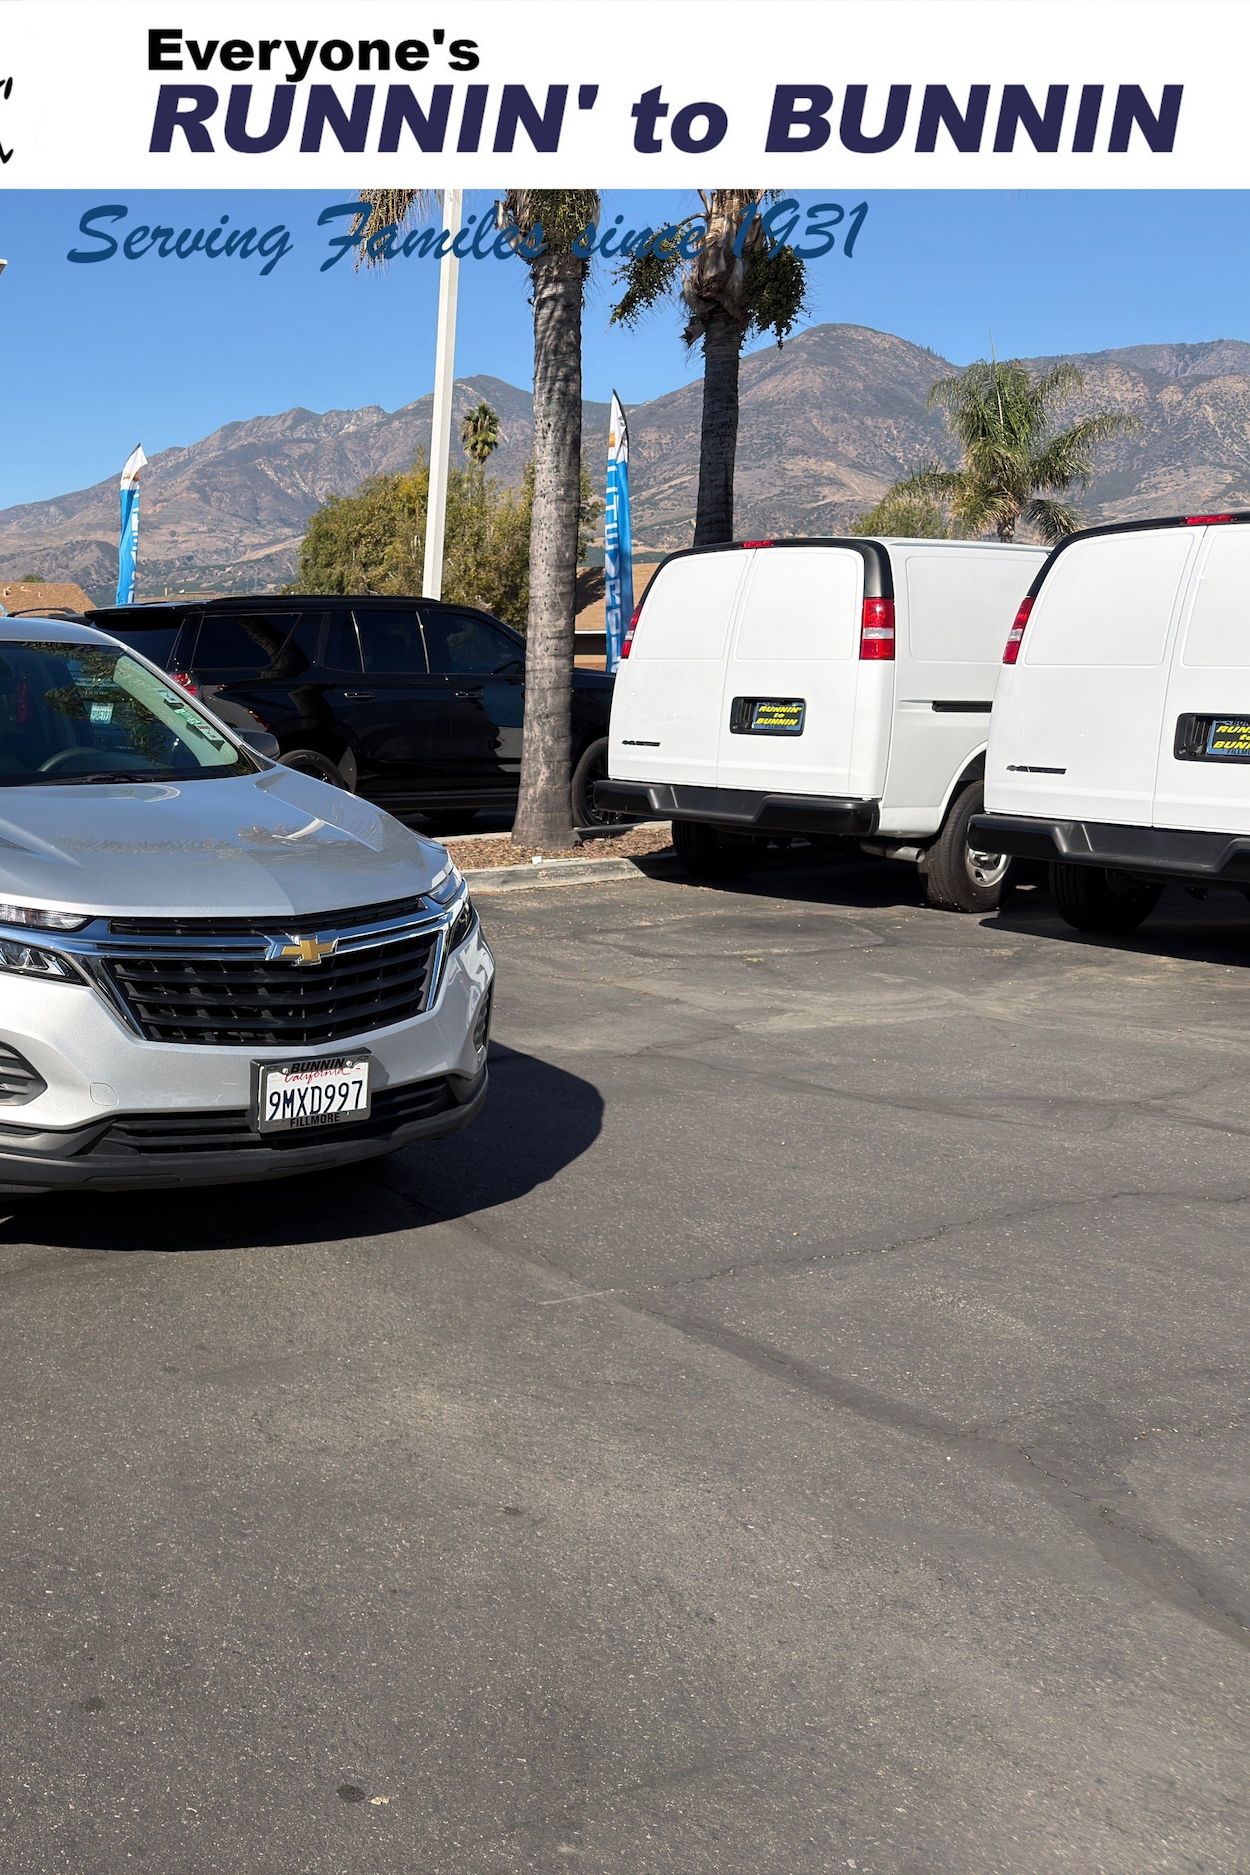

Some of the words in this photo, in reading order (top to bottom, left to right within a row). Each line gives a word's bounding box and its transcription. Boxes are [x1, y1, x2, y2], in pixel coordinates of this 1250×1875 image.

[756, 718, 798, 726] BUNNIN
[1216, 725, 1250, 733] RUN
[291, 1058, 345, 1074] BUNNIN
[284, 1066, 351, 1084] California
[268, 1080, 363, 1121] 9MXD997
[290, 1112, 340, 1128] FILLMORE
